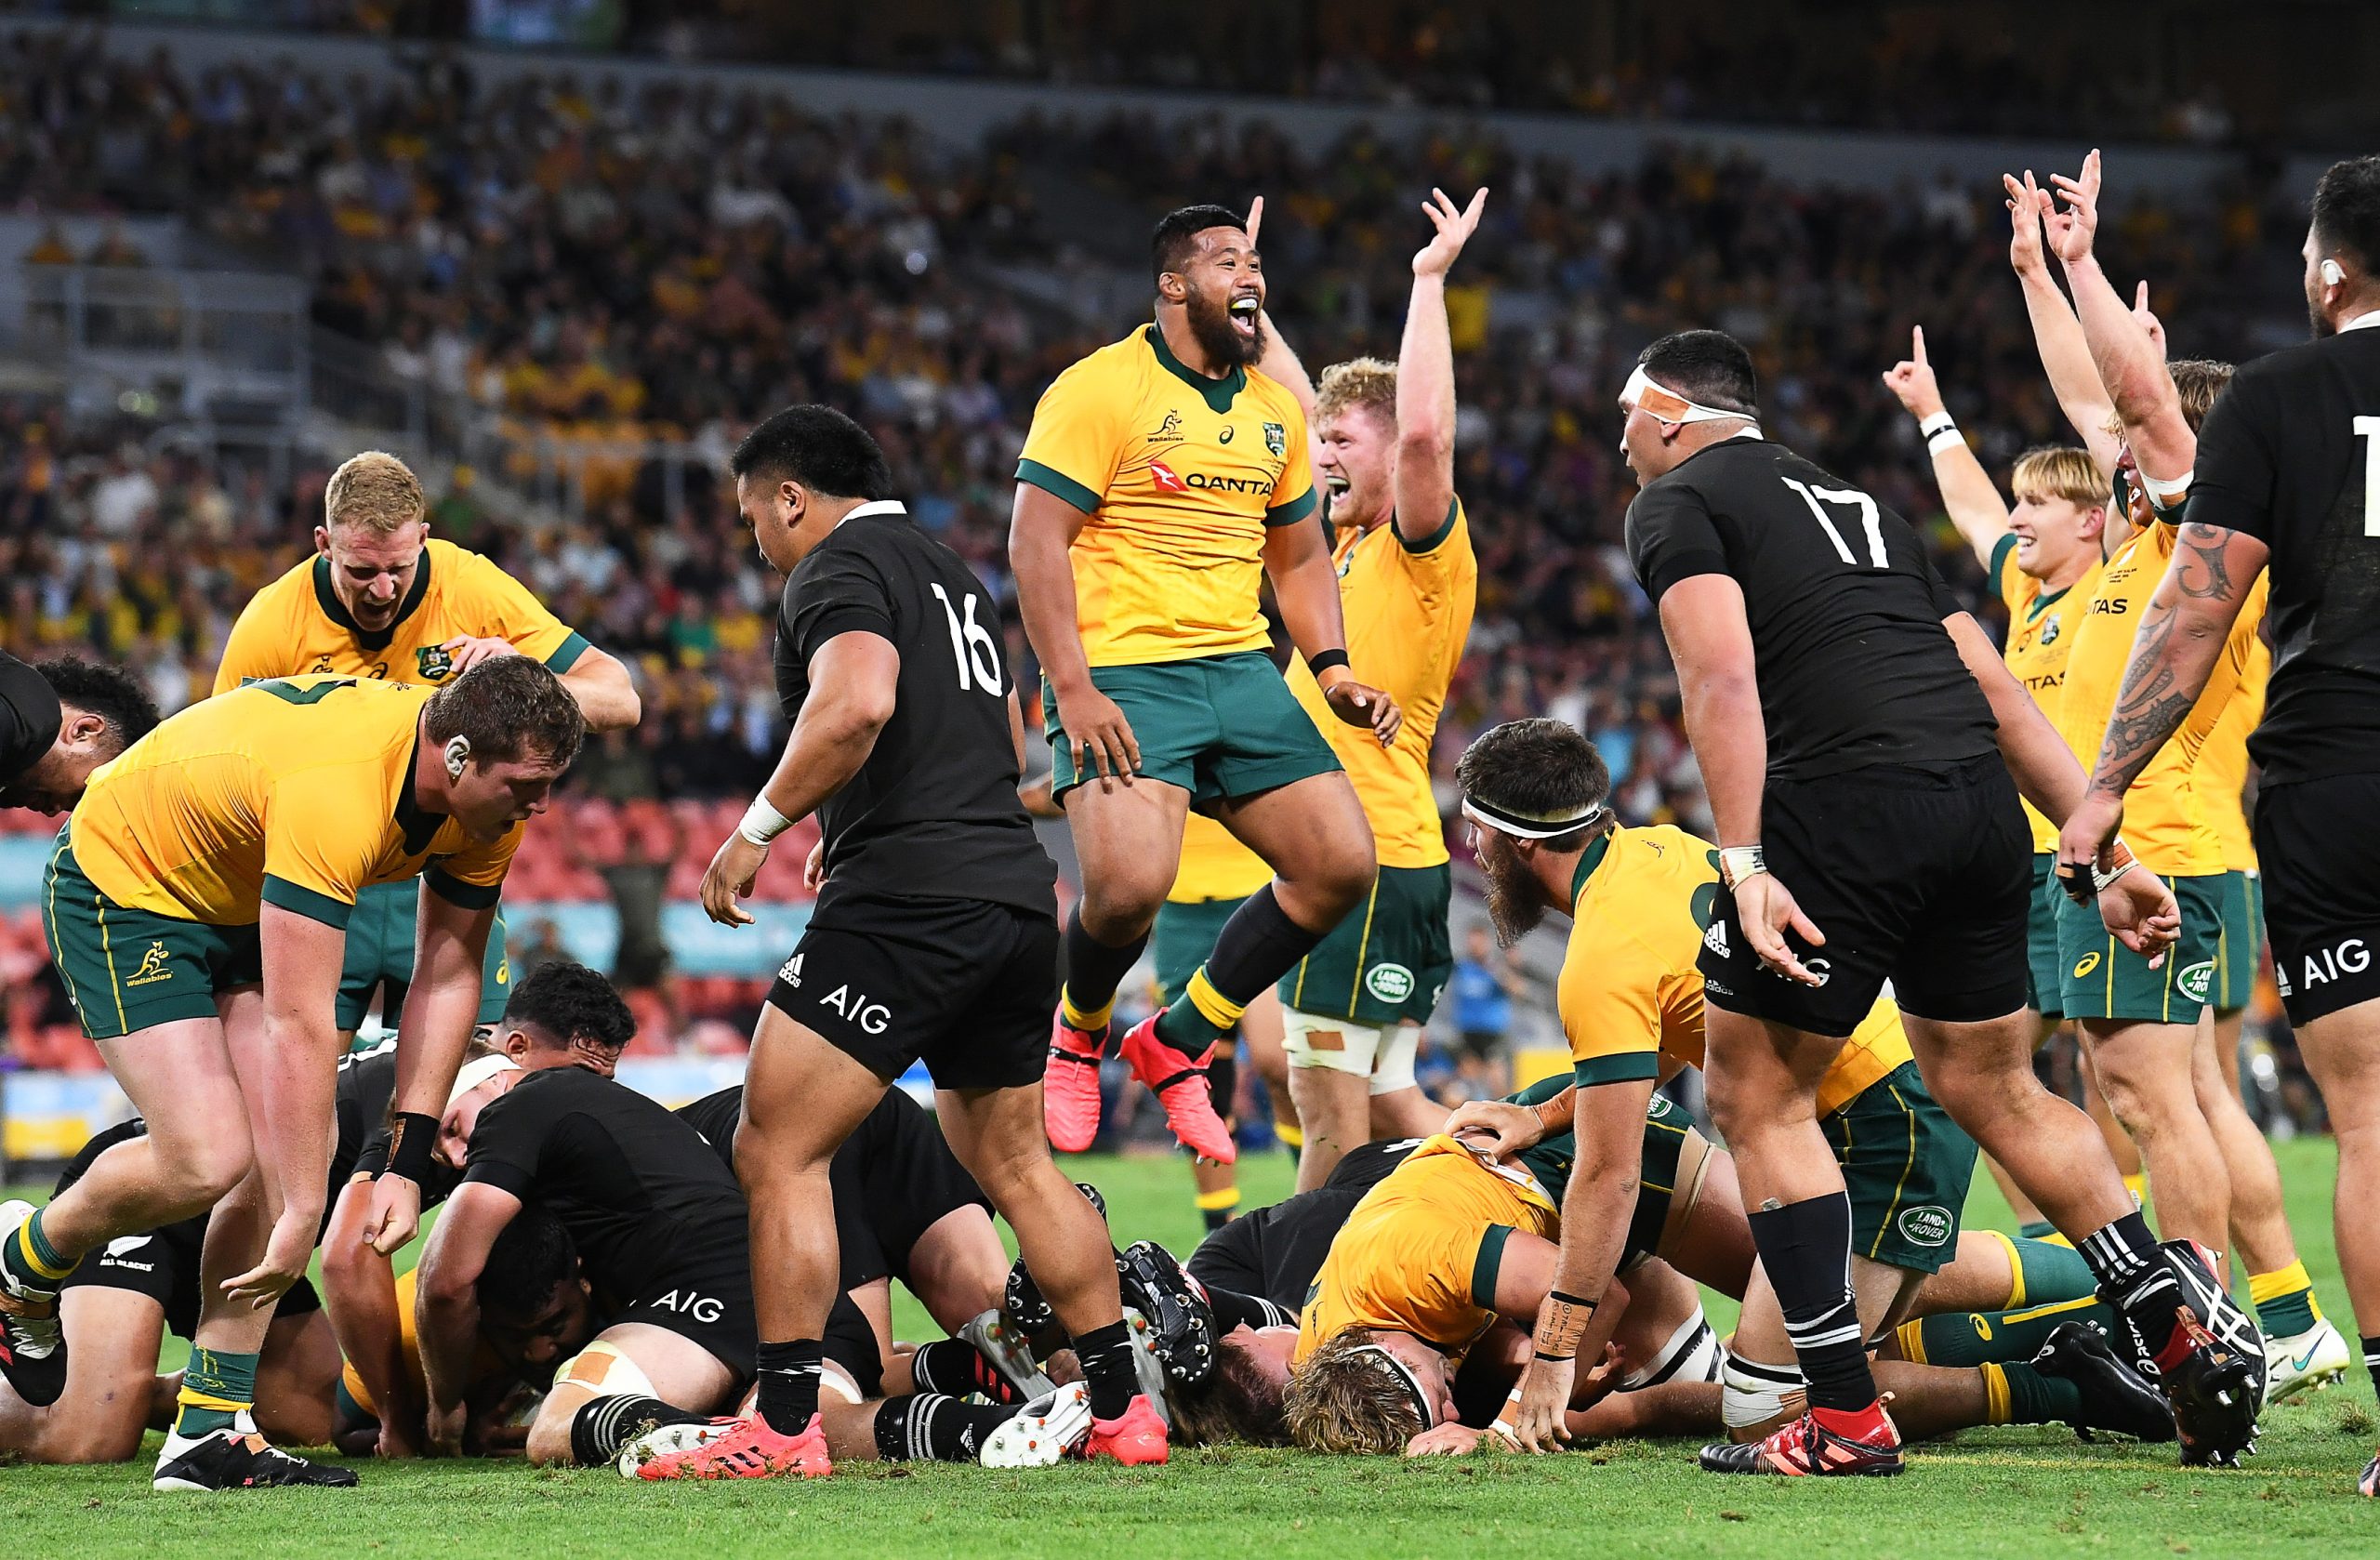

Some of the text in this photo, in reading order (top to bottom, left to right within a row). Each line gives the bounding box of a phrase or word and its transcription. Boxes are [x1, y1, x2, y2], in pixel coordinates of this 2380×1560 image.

[1185, 473, 1272, 496] QANTA
[1781, 476, 1890, 569] 17
[931, 583, 1003, 697] 16
[2305, 939, 2371, 990] AIG
[126, 973, 172, 986] Wallabies
[819, 985, 892, 1035] AIG
[1911, 1223, 1944, 1239] ROVER
[1916, 1211, 1942, 1226] LAND
[99, 1258, 116, 1266] ALL
[650, 1289, 724, 1323] AIG
